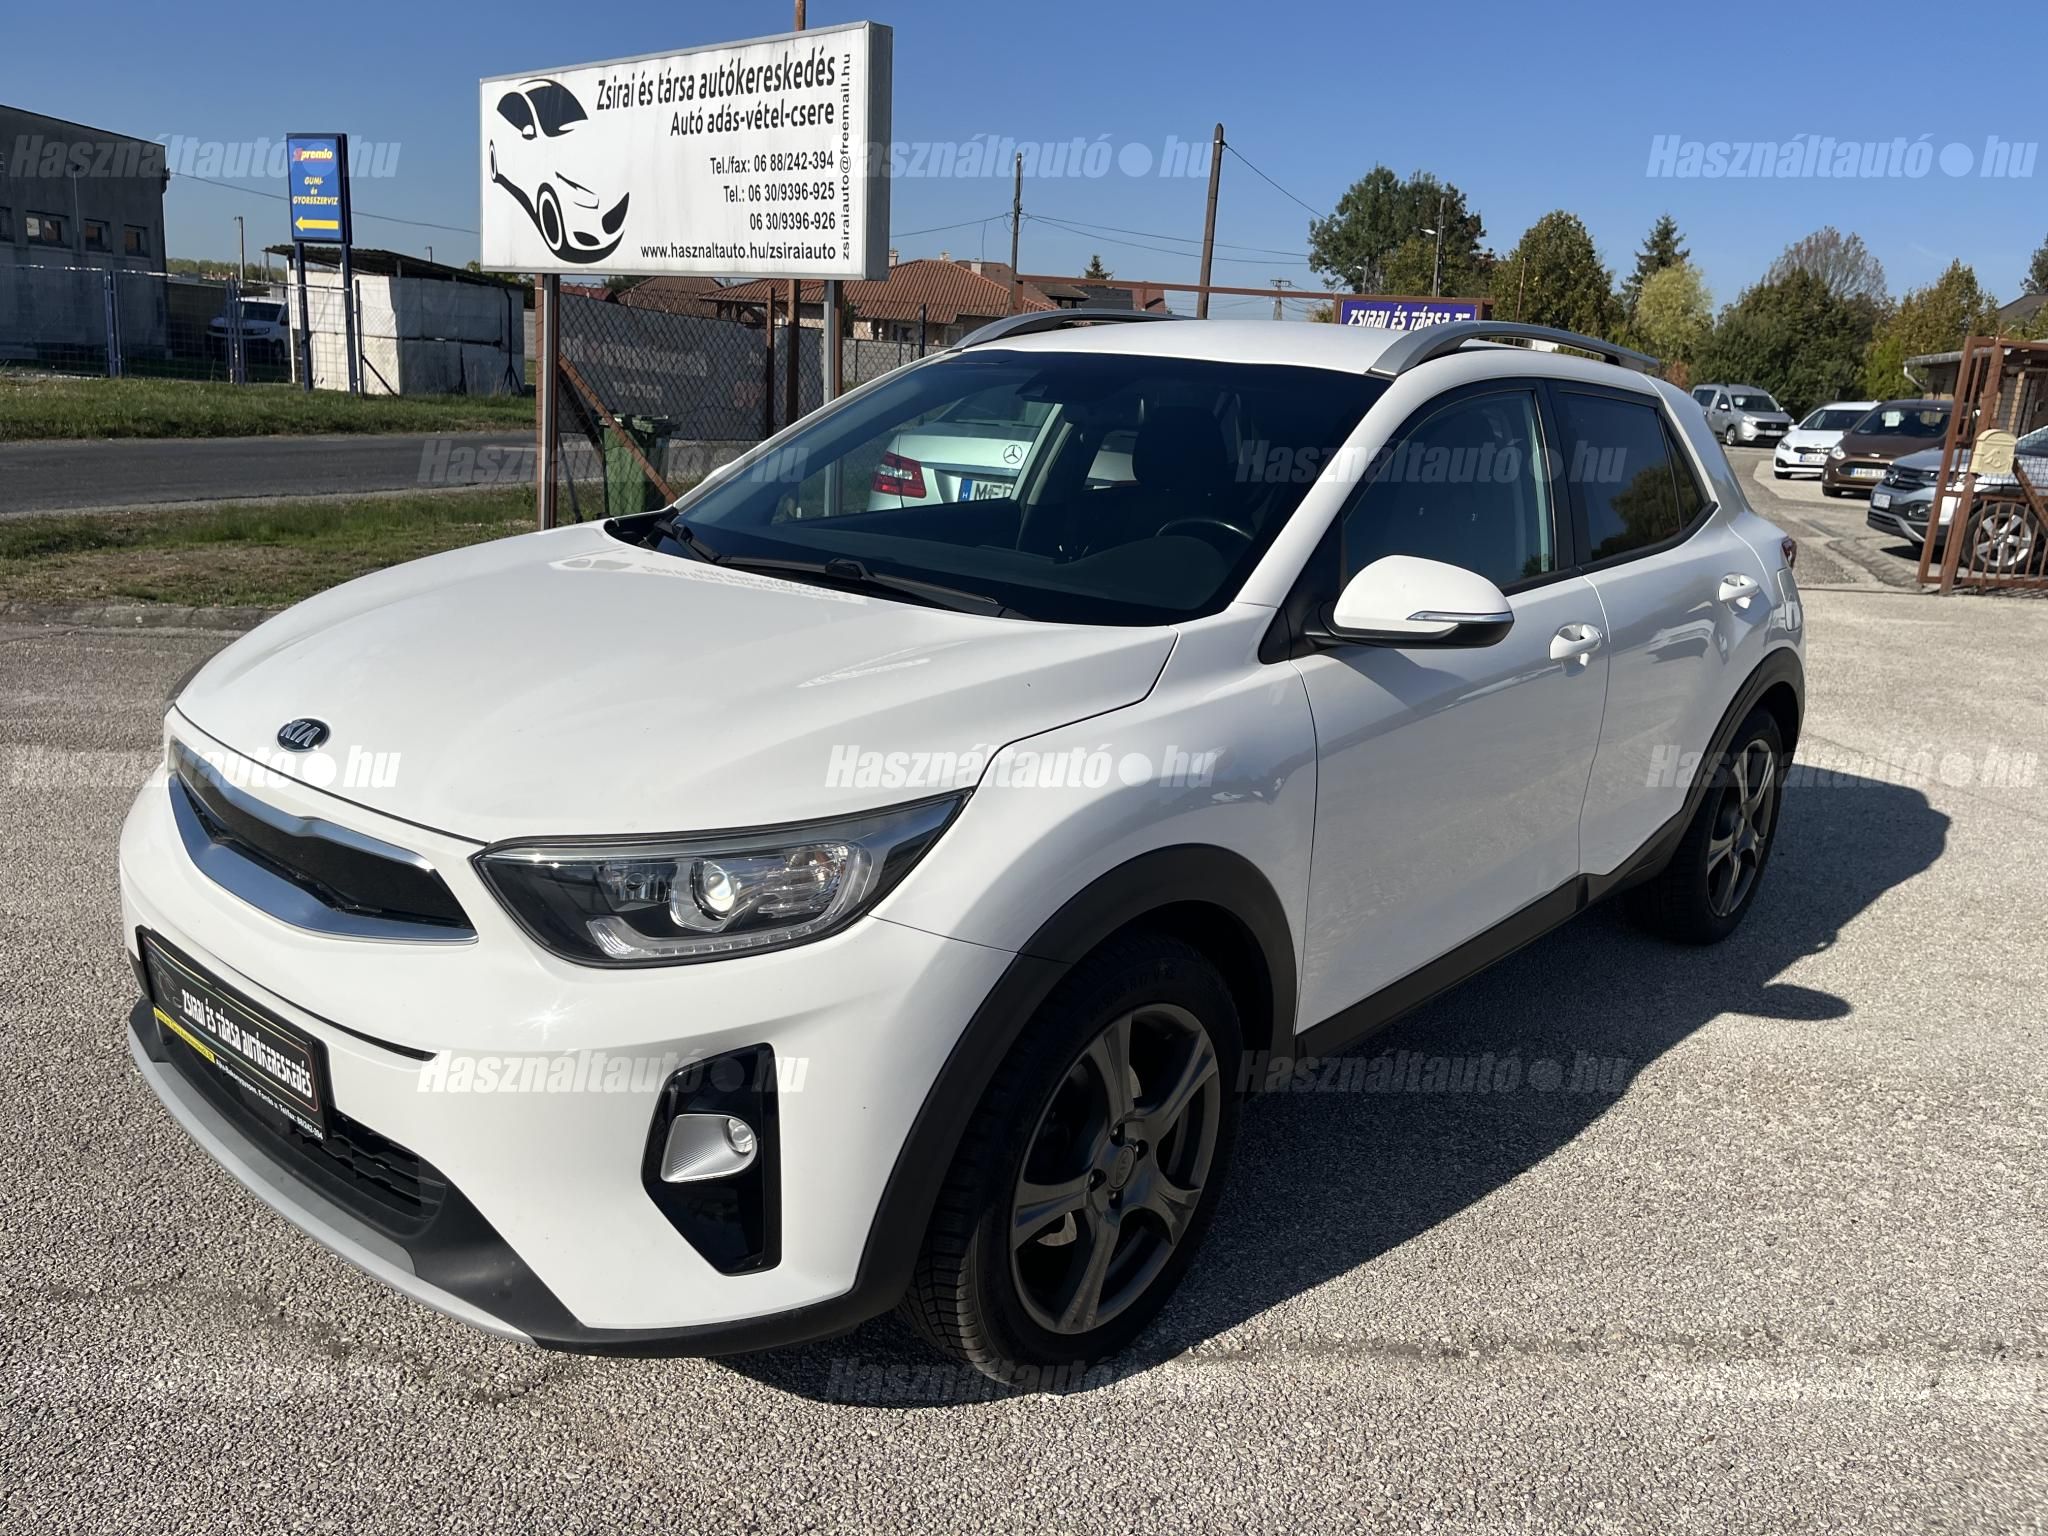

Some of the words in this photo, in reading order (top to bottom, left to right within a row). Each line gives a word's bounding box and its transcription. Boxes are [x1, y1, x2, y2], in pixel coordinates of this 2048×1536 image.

[597, 72, 635, 110] Zsirai
[638, 71, 653, 107] és
[657, 67, 695, 104] társa
[699, 47, 835, 98] autókereskedés
[670, 107, 703, 136] Autó
[707, 98, 834, 134] adás-vétel-csere
[301, 148, 333, 161] premio
[710, 156, 751, 174] Tel./fax:
[754, 154, 767, 172] 06
[770, 151, 834, 171] 88/242-394
[304, 177, 323, 185] GUMI-
[723, 185, 745, 203] Tel.:
[748, 184, 761, 202] 06
[765, 182, 835, 201] 30/9396-925
[750, 213, 763, 230] 06
[766, 212, 836, 230] 30/9396-926
[641, 242, 836, 260] www.hasznaltauto.hu/zsiraiauto
[1348, 309, 1390, 328] ZSIRAI
[281, 722, 320, 747] KIA
